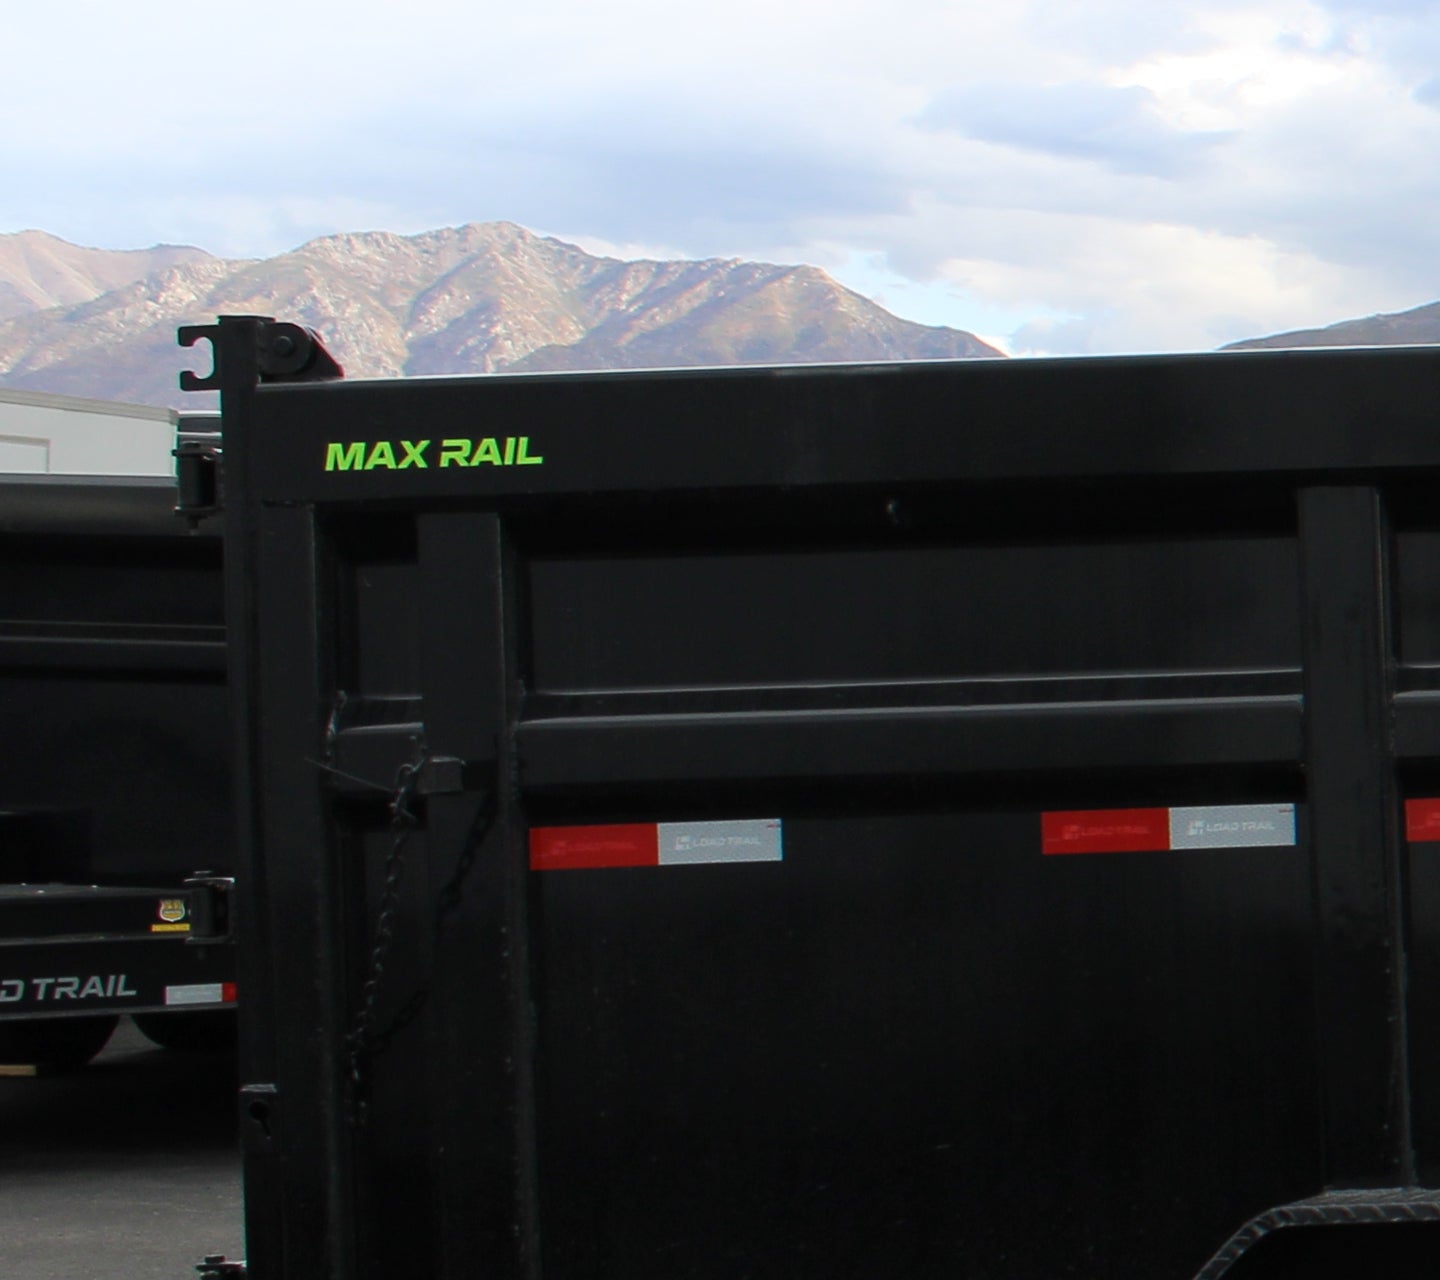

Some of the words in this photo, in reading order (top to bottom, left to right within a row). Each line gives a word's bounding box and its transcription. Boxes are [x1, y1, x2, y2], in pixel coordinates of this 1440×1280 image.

[325, 440, 431, 471] MAX
[440, 436, 544, 467] RAIL
[33, 975, 136, 1000] TRAIL
